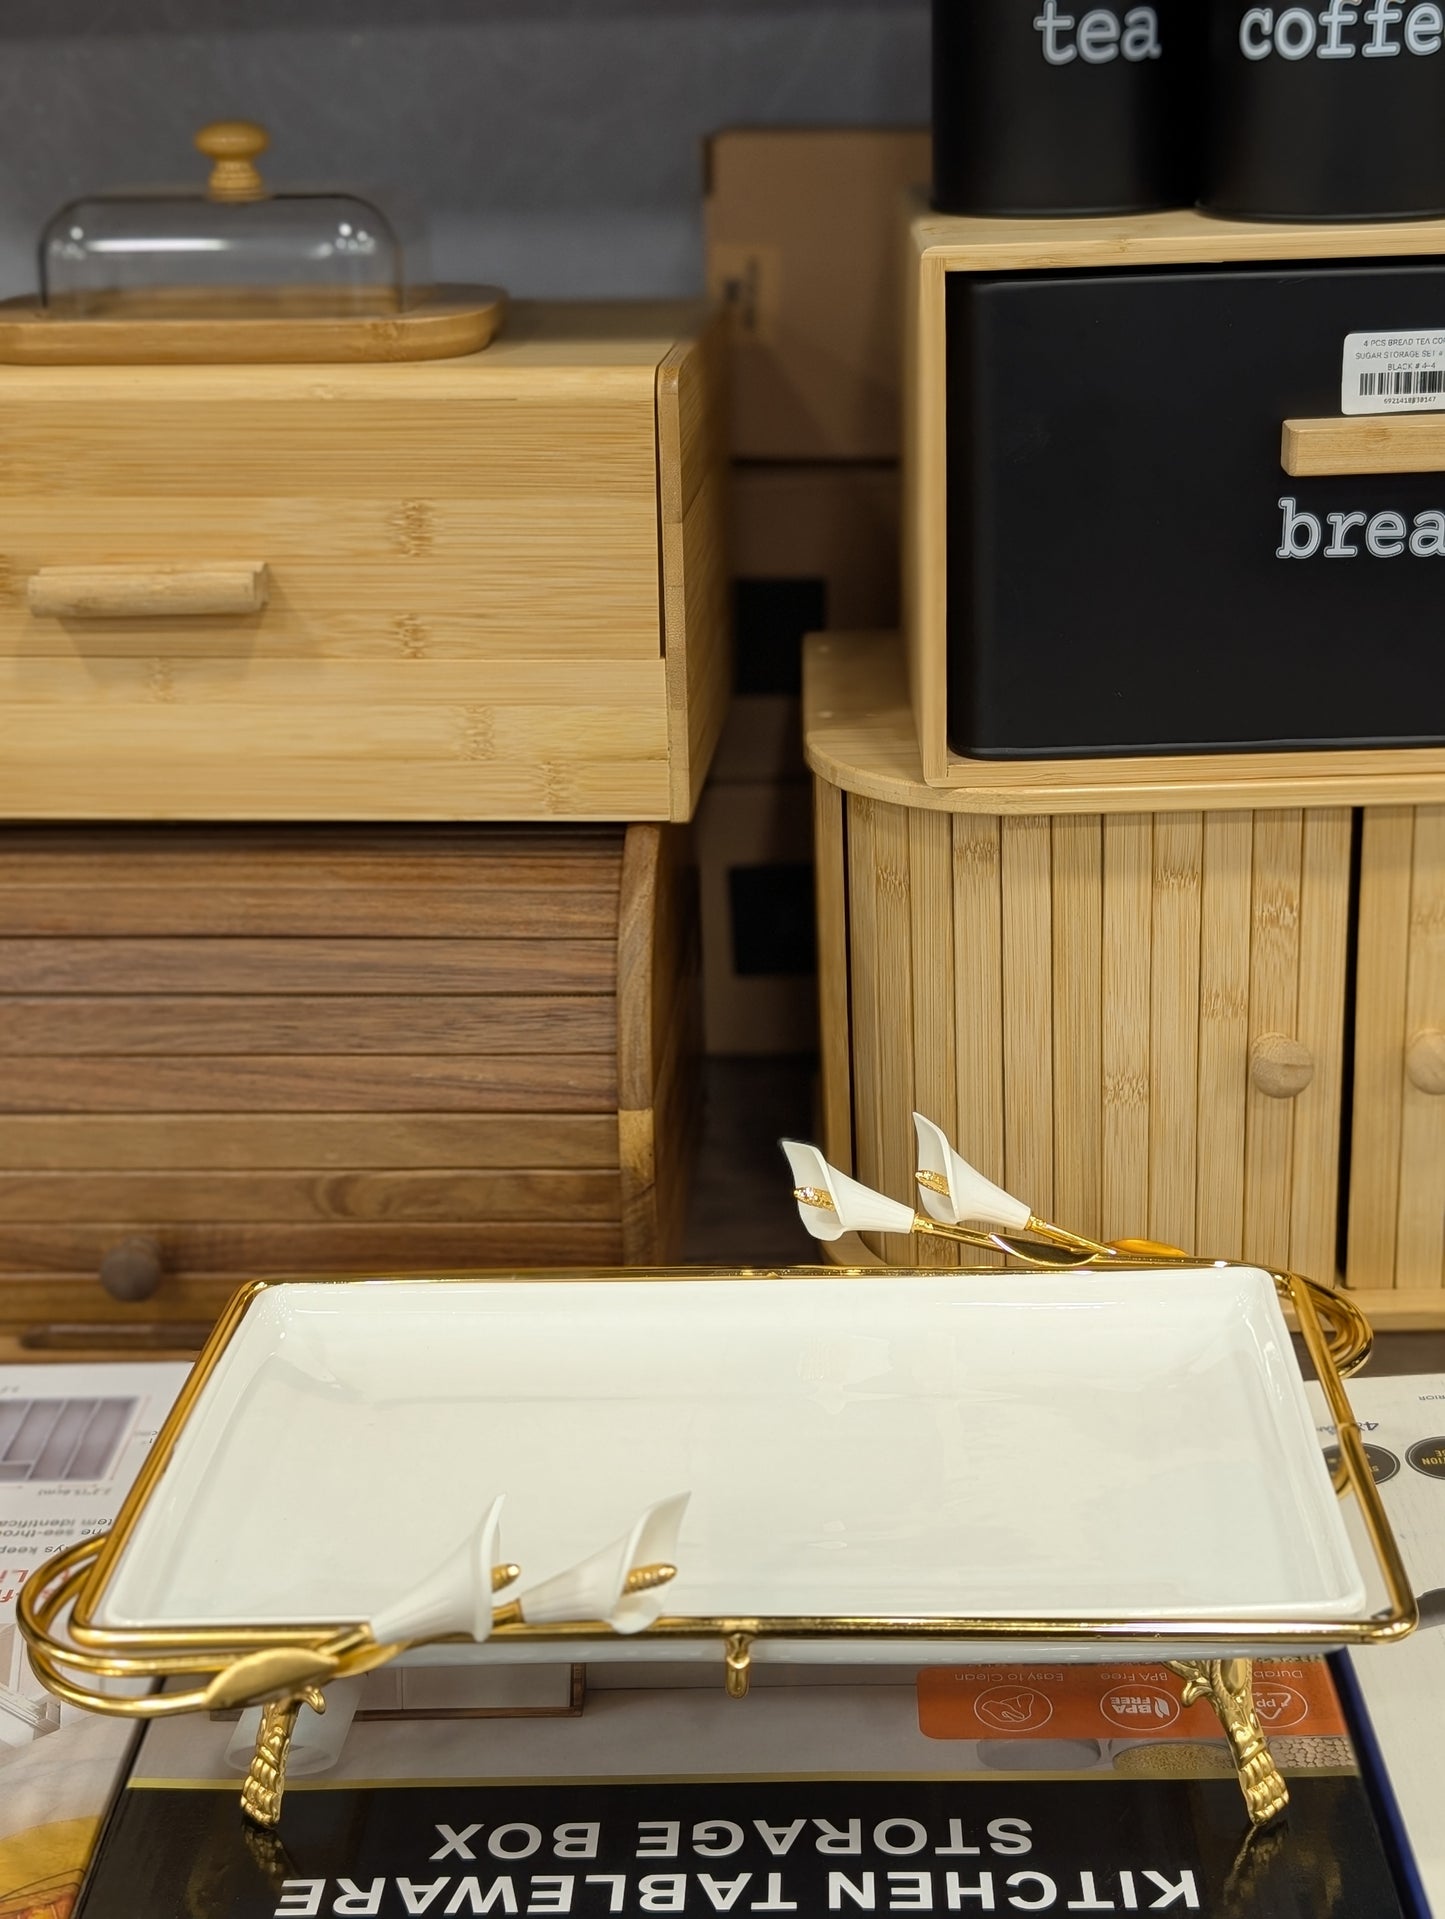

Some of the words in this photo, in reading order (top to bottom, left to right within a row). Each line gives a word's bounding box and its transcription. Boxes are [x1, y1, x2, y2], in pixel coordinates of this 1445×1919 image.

[1034, 0, 1162, 65] tea
[1371, 339, 1386, 347] PCS
[1388, 338, 1413, 347] BREAD
[1416, 337, 1430, 346] TEA
[1355, 351, 1382, 360] SUGAR
[1384, 350, 1419, 359] STORAGE
[1421, 349, 1435, 358] SET
[1387, 362, 1413, 371] BLACK
[1276, 497, 1445, 559] brea
[954, 1672, 1003, 1682] Clean
[1008, 1673, 1024, 1682] to
[1028, 1671, 1064, 1682] Easy
[1100, 1672, 1135, 1682] Free
[1139, 1672, 1168, 1682] BPA
[1110, 1696, 1151, 1705] FREE
[1112, 1704, 1152, 1714] BPA
[429, 1822, 600, 1860] BOX
[636, 1818, 1033, 1858] STORAGE
[273, 1872, 798, 1918] TABLEWARE
[829, 1870, 1200, 1911] KITCHEN
